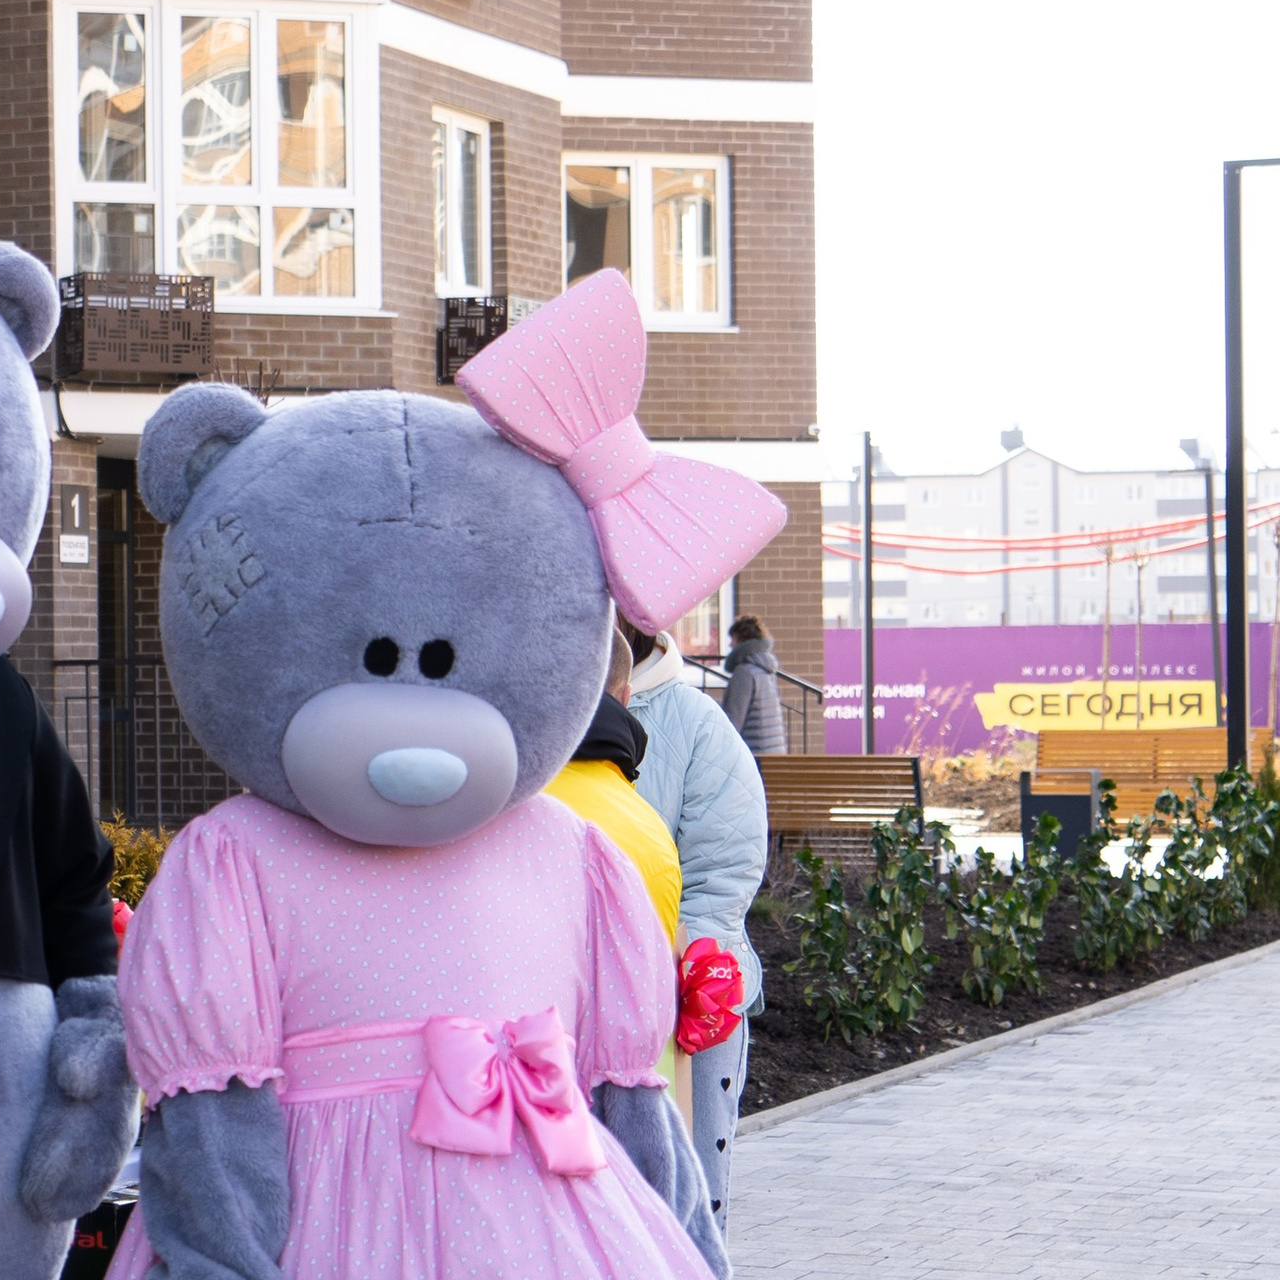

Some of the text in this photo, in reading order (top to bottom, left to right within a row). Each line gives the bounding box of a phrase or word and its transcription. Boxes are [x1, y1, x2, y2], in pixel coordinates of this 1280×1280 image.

[71, 493, 79, 528] 1
[1021, 664, 1086, 676] ЖИЛОЙ
[1008, 693, 1203, 721] СЕГОДНЯ
